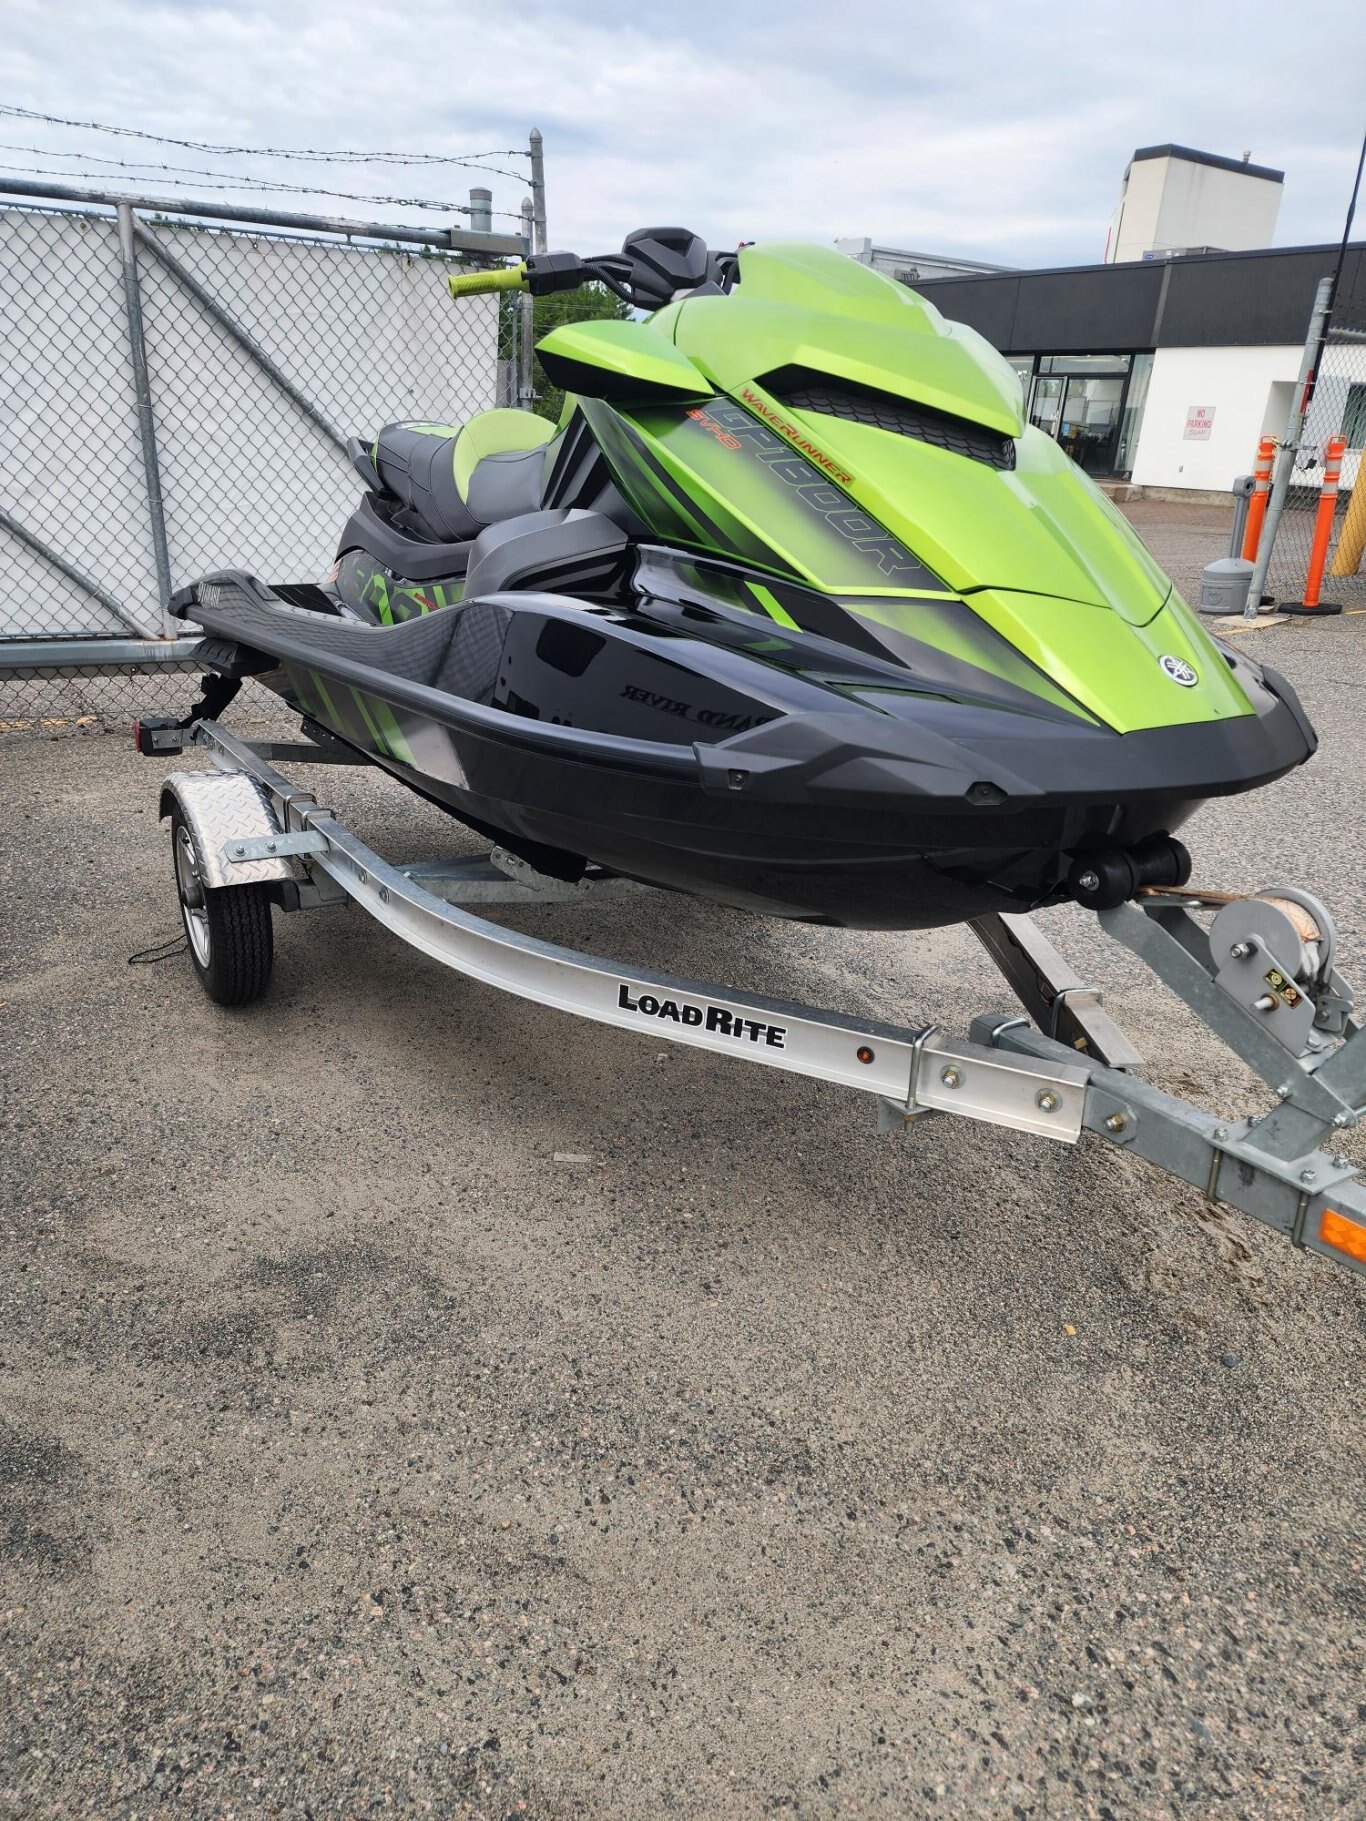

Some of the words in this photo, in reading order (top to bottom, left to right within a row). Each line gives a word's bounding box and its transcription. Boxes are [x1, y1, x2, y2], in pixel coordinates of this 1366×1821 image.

[685, 408, 741, 450] SVHO
[1187, 419, 1212, 428] PARKING
[1196, 409, 1206, 418] NO
[741, 389, 851, 484] WAVERUNNER
[704, 406, 922, 577] GP1800R
